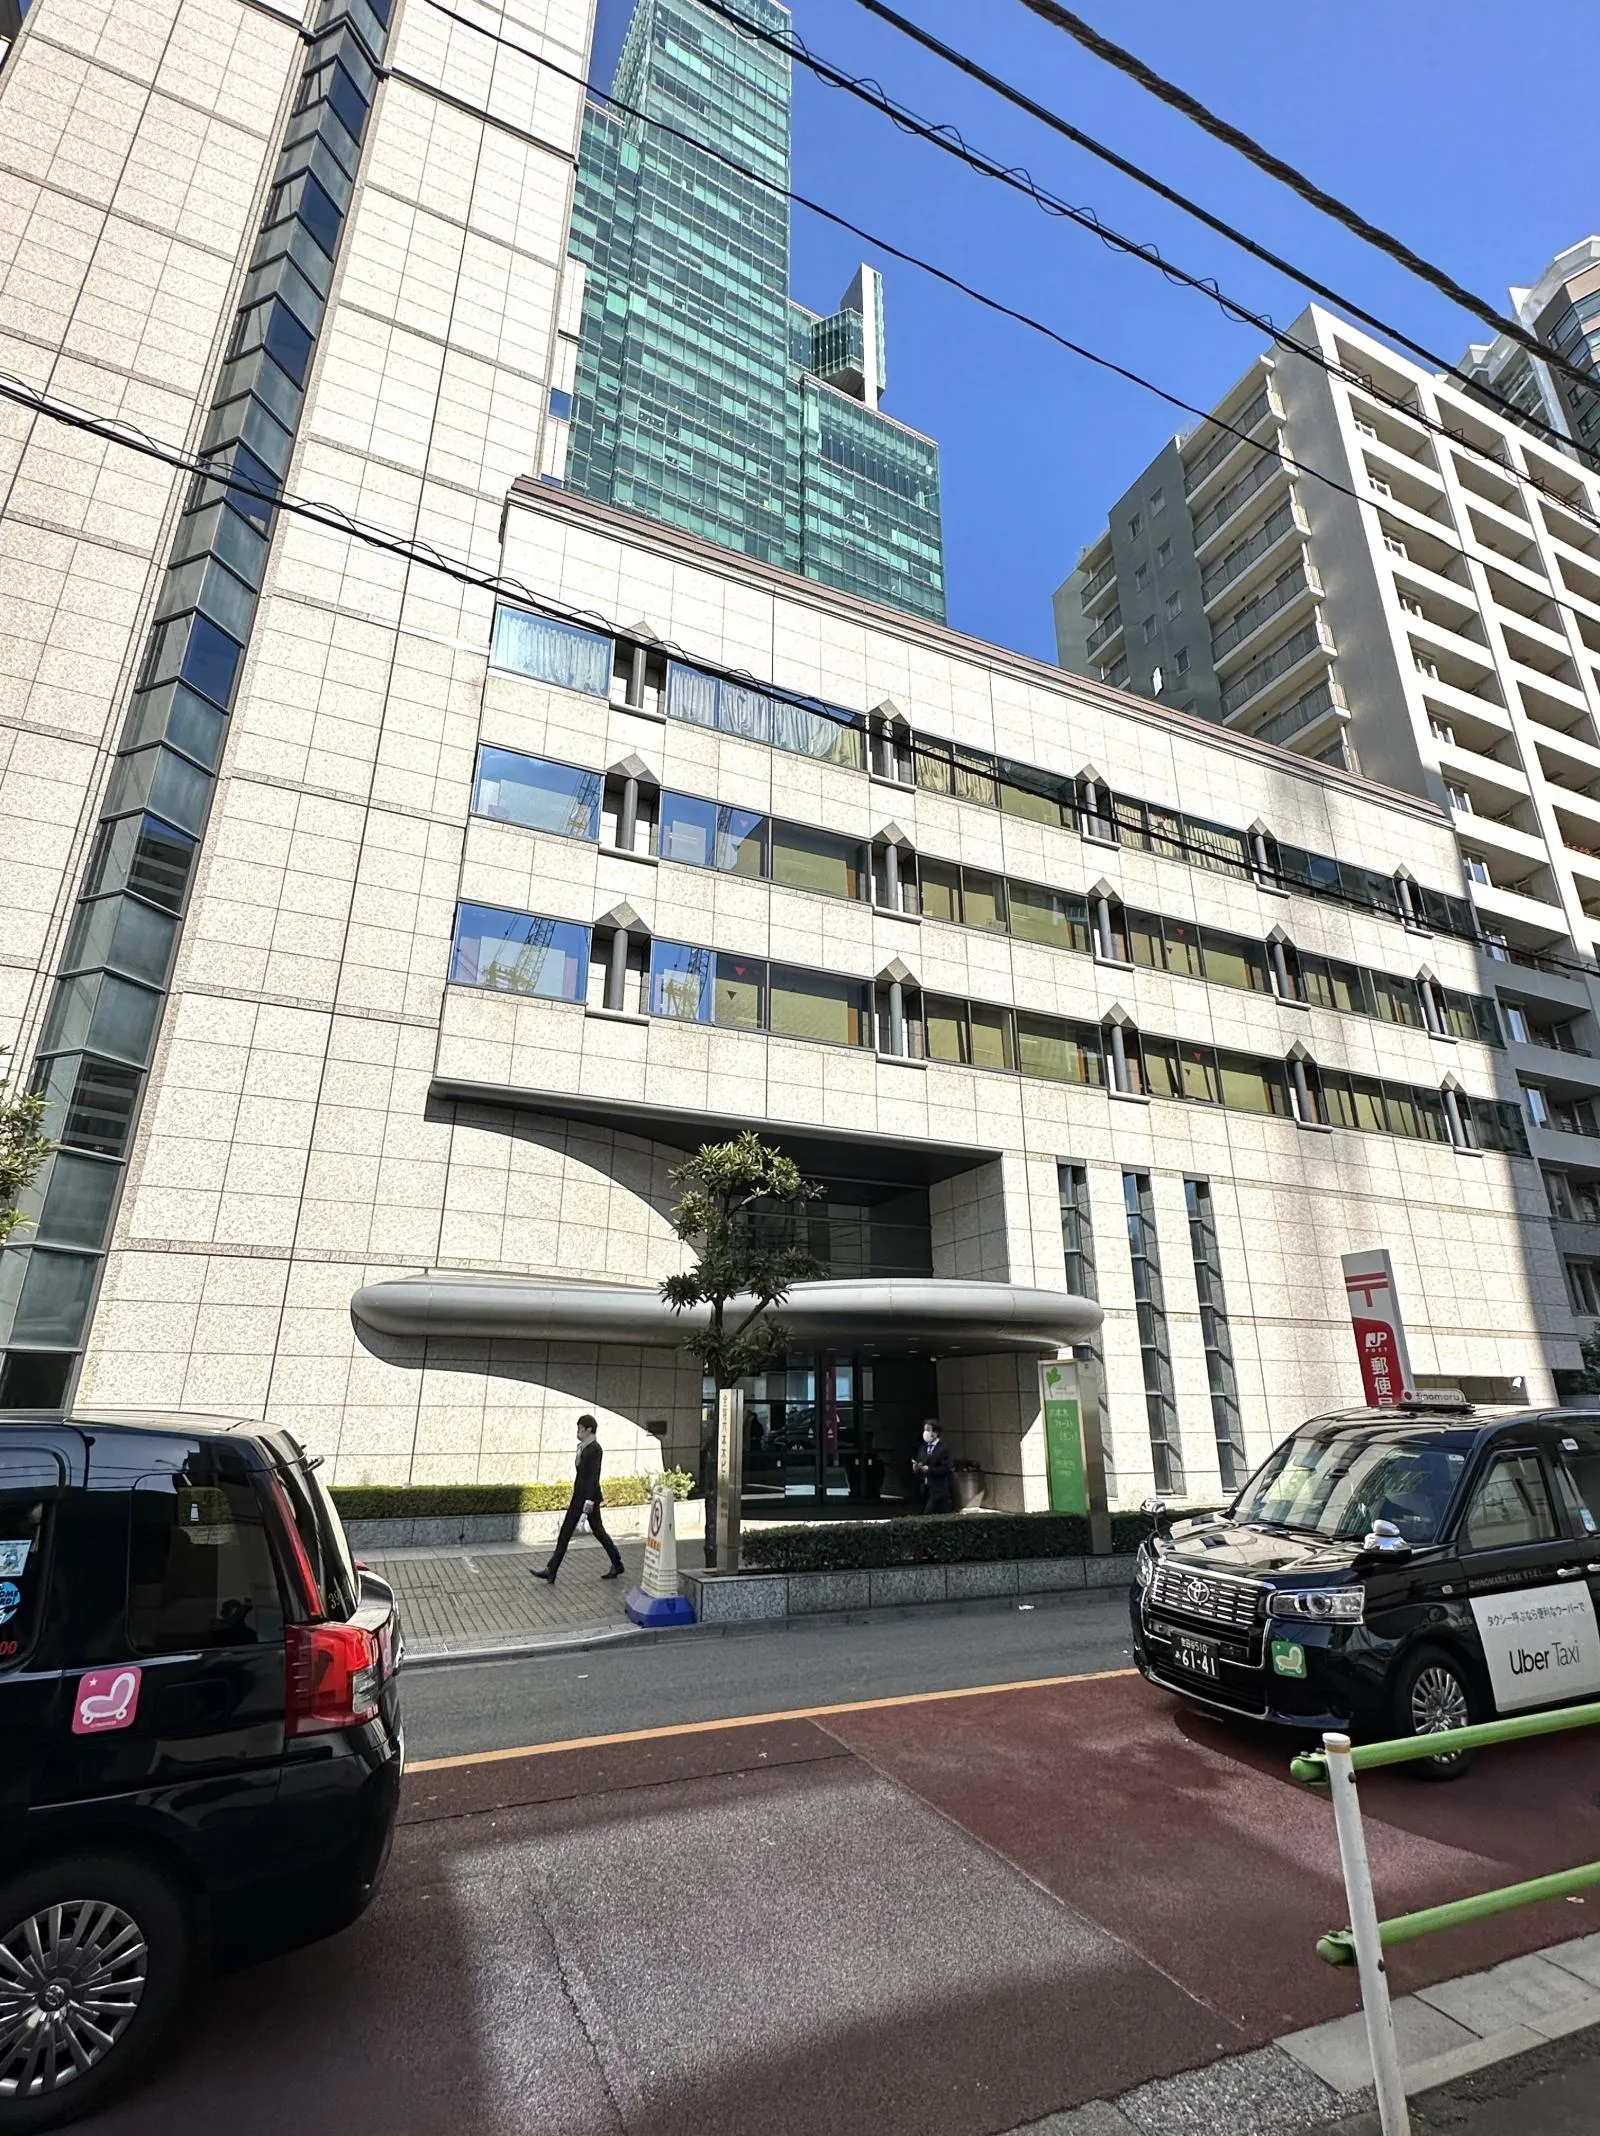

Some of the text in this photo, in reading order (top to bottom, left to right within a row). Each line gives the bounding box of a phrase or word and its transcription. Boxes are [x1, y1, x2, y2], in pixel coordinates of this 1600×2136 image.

[1182, 1649, 1216, 1676] 61-41
[1509, 1640, 1580, 1675] Uber Taxi
